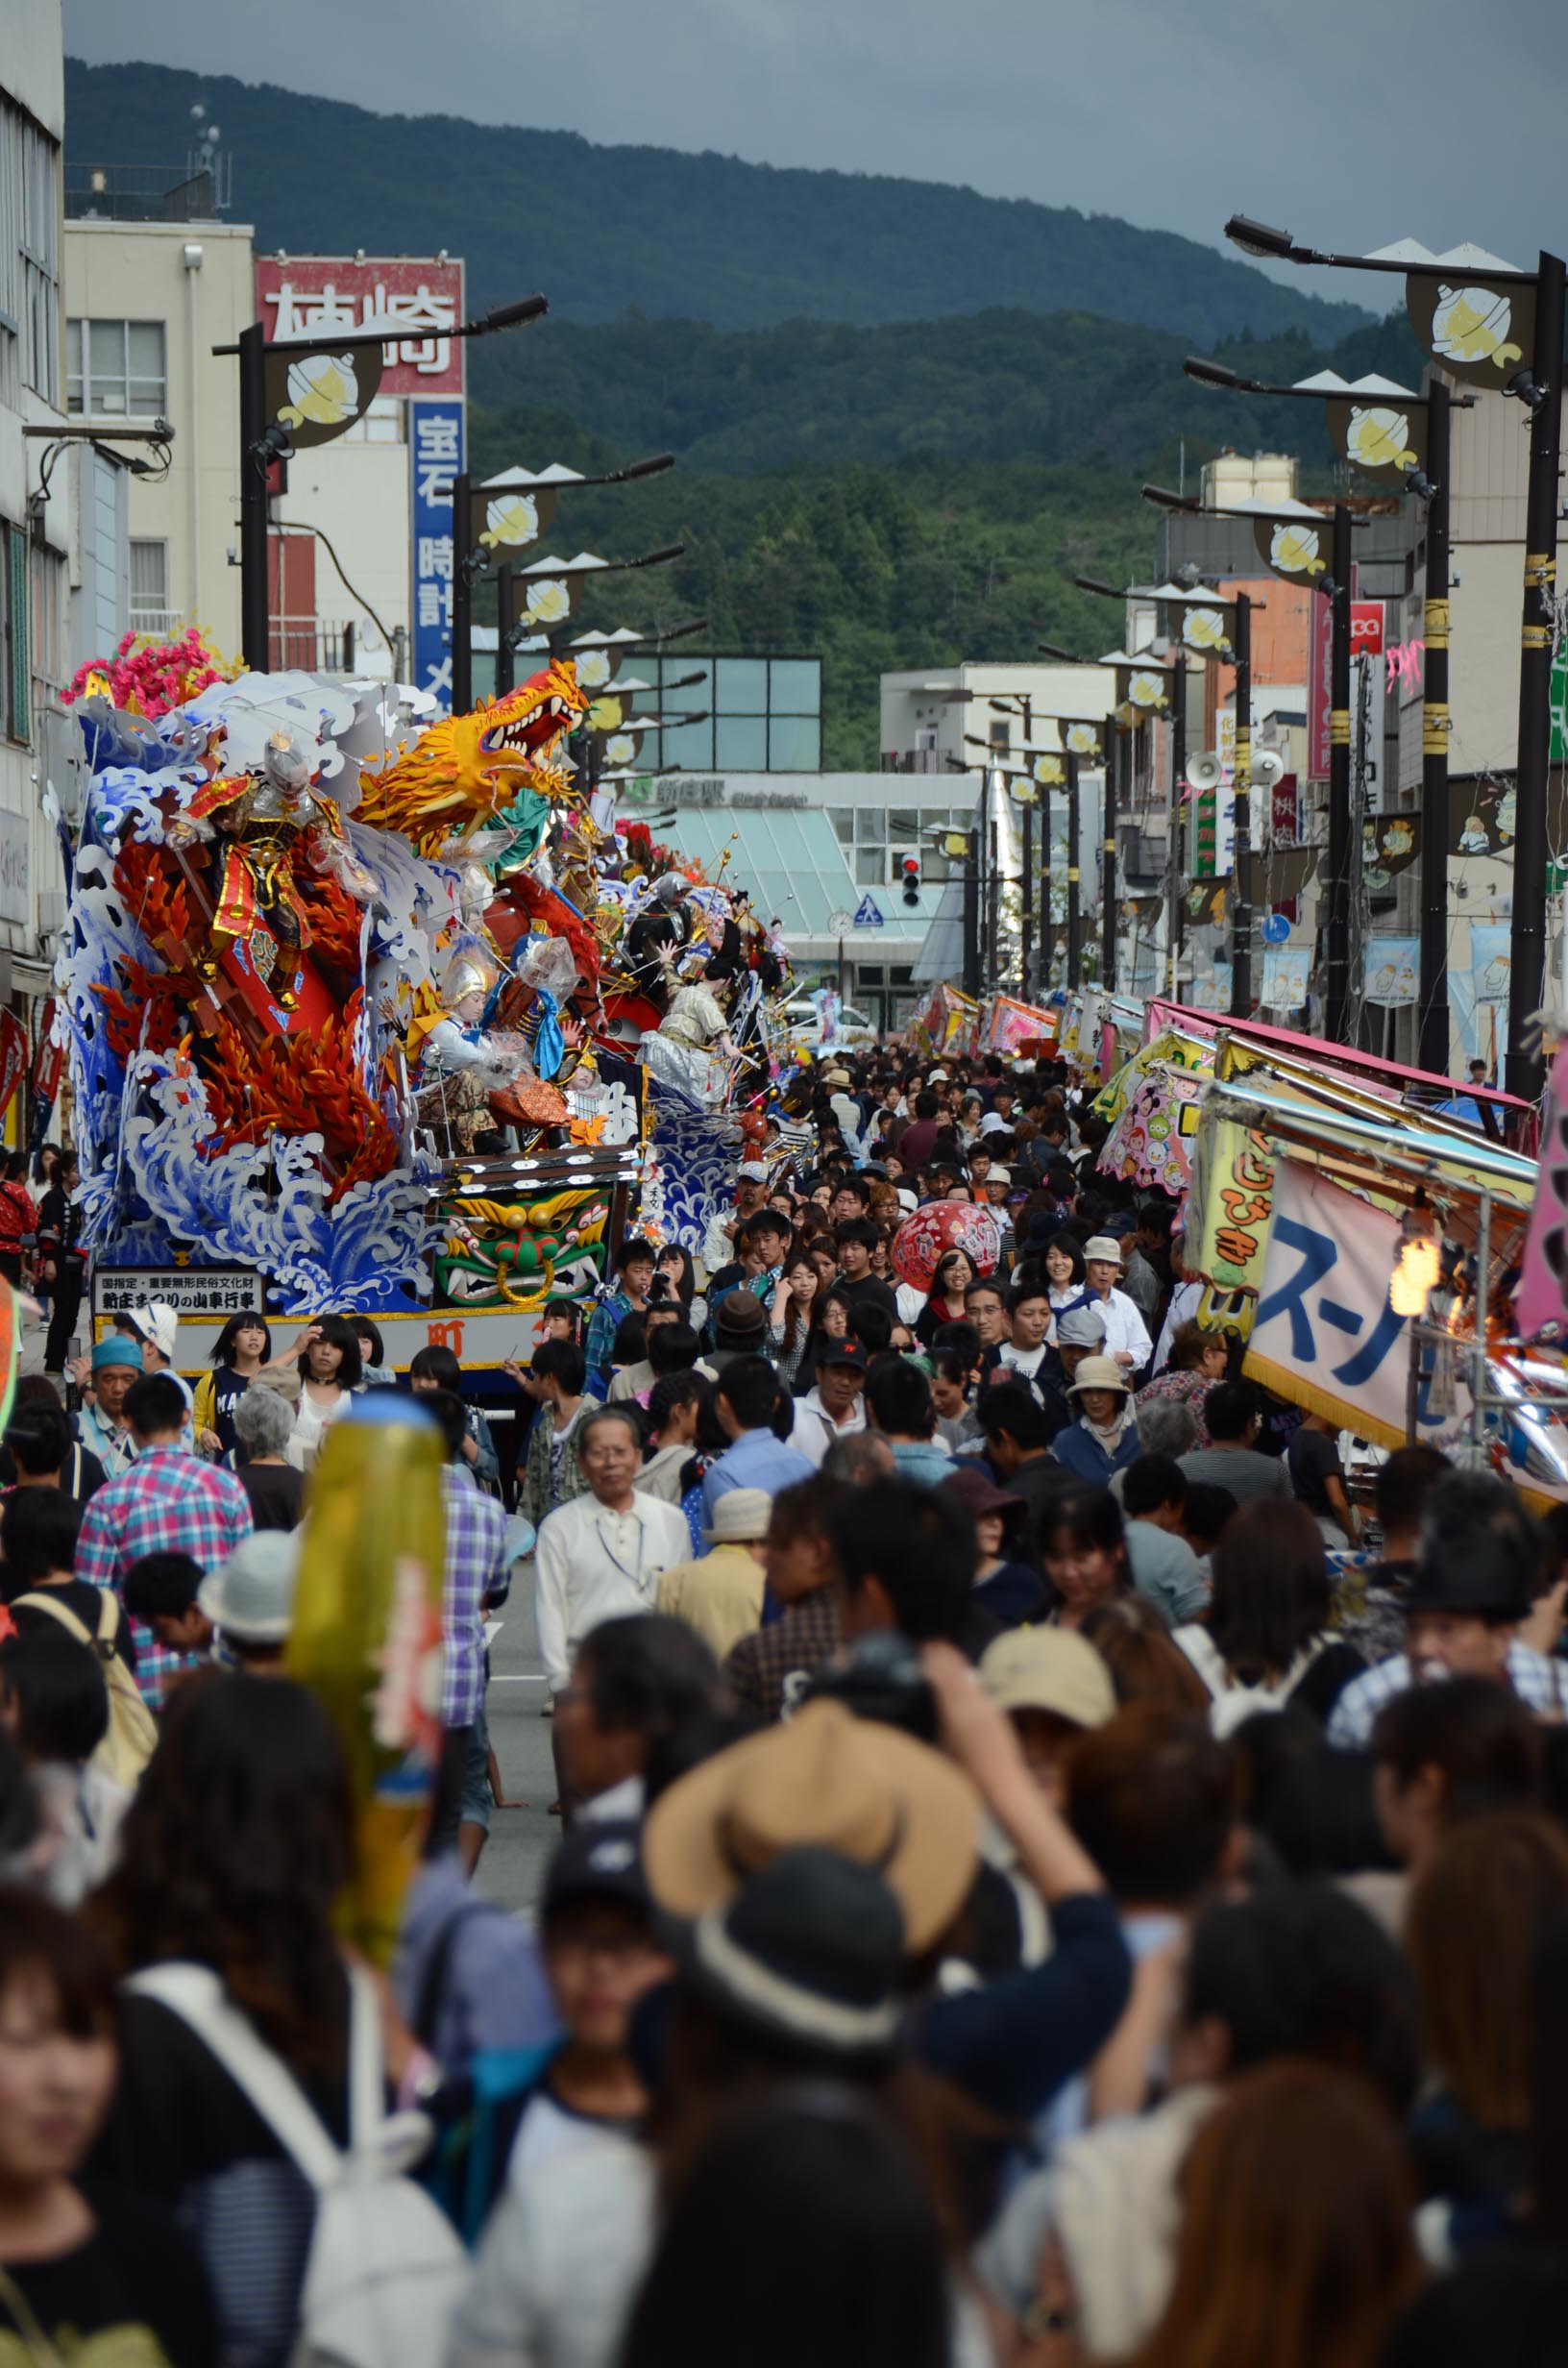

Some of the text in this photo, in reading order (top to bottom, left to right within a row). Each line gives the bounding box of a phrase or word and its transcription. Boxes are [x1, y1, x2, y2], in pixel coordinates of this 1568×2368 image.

[417, 416, 458, 507] 宝石
[102, 1277, 254, 1290] 国指定・重要無形民俗文化財
[102, 1292, 255, 1310] 新庄まつりの山車行事
